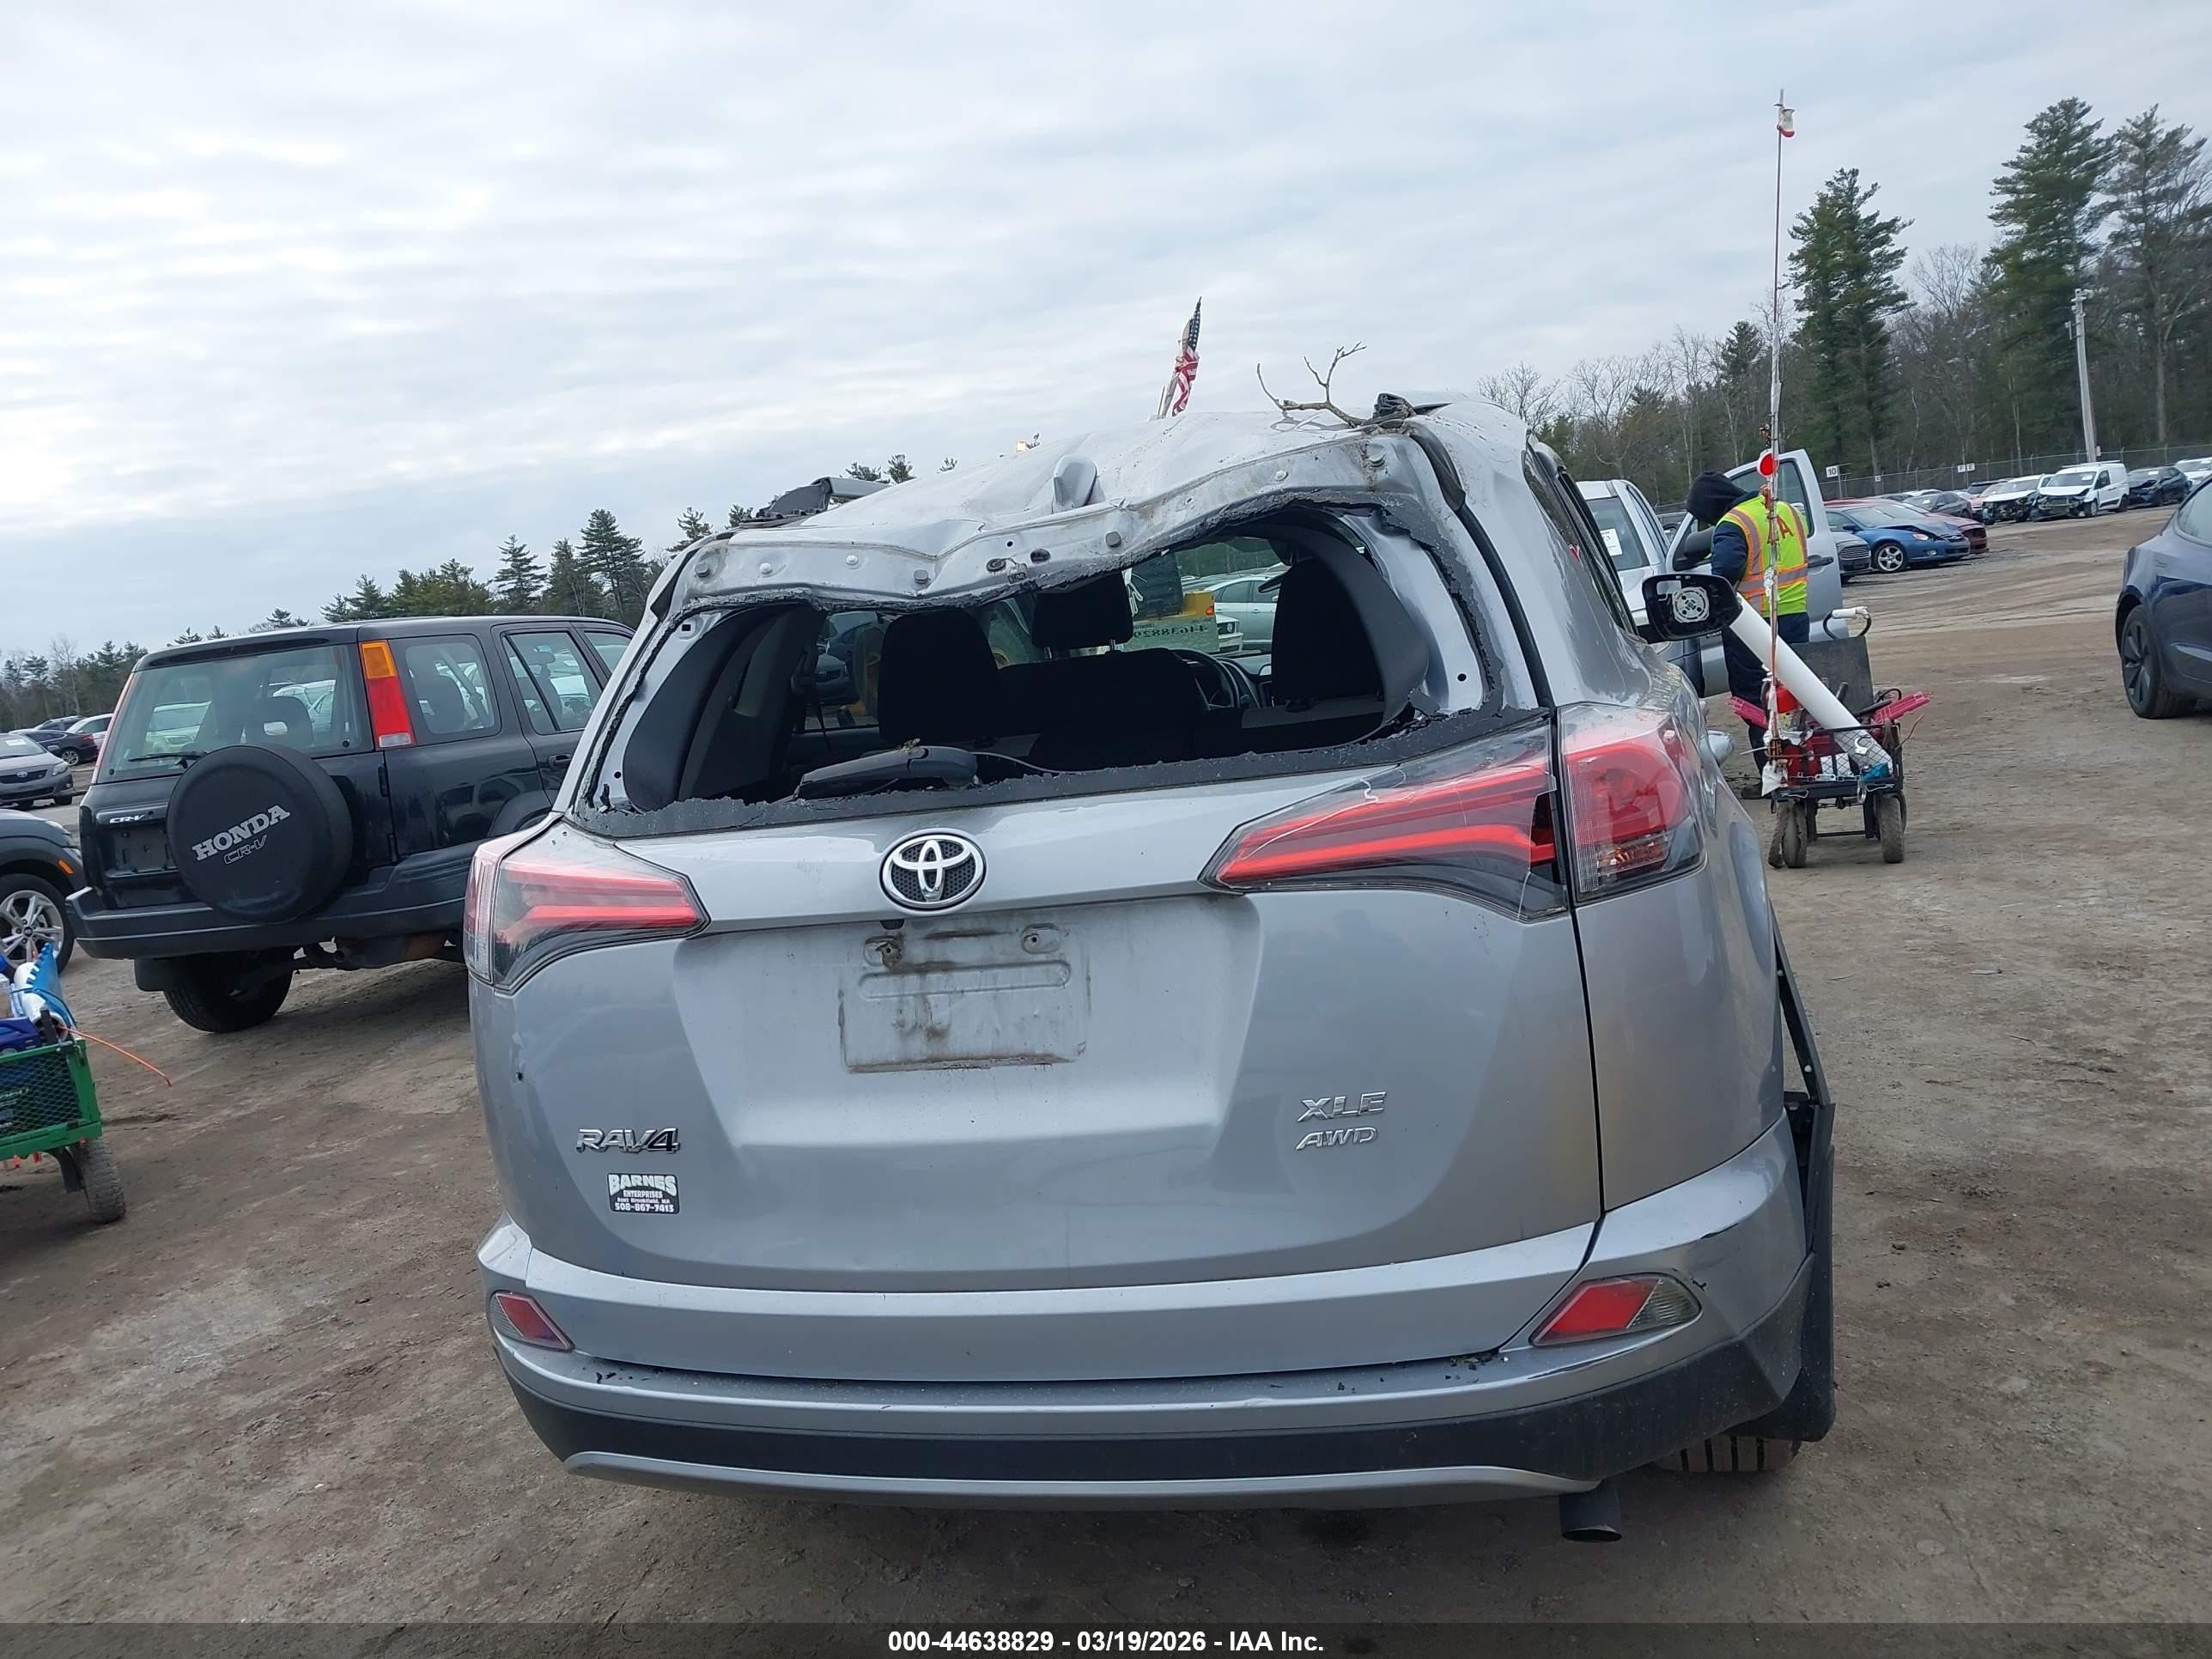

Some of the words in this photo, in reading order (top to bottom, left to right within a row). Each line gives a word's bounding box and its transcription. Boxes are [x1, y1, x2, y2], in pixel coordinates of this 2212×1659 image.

[1827, 467, 1837, 476] 10
[109, 814, 145, 823] CR-V
[191, 805, 291, 860] HONDA
[223, 834, 268, 865] CR-V
[1296, 1091, 1388, 1122] XLE
[575, 1127, 681, 1154] RAV4
[1295, 1126, 1377, 1151] AWD
[608, 1174, 678, 1196] BARNES
[623, 1189, 663, 1198] ENTERPRISES
